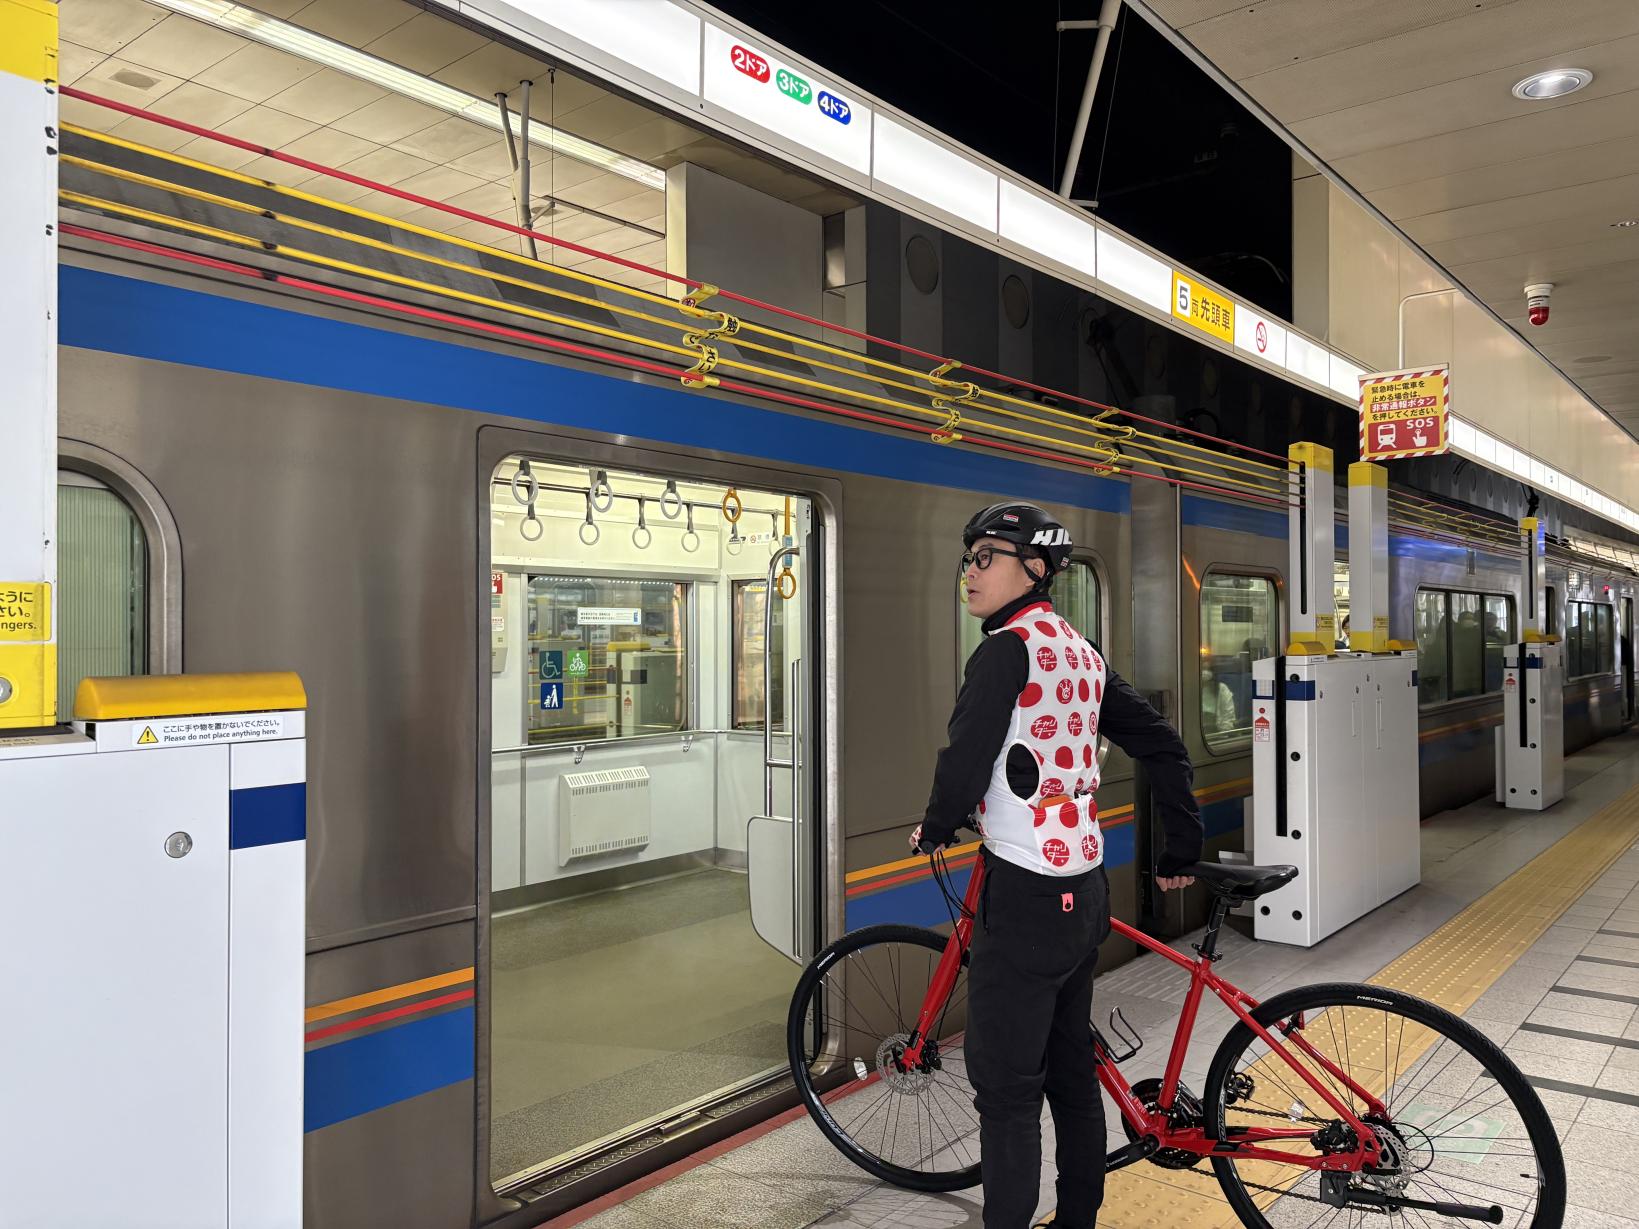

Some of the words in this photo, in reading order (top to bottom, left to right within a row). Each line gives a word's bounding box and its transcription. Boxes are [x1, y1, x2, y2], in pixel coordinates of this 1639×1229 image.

[734, 49, 767, 76] 2ドア
[779, 72, 809, 97] 3ドア
[820, 95, 849, 118] 4ドア
[1371, 380, 1425, 394] 緊急時に電車を
[1371, 397, 1436, 412] 非常通報ボタン
[1372, 407, 1438, 421] を押してください。
[1406, 417, 1434, 429] SOS
[163, 719, 280, 734] ここに手や物を置かないでください。
[213, 731, 230, 740] place
[232, 729, 260, 738] anything
[1042, 842, 1067, 851] チャリ
[1046, 851, 1070, 863] ダー
